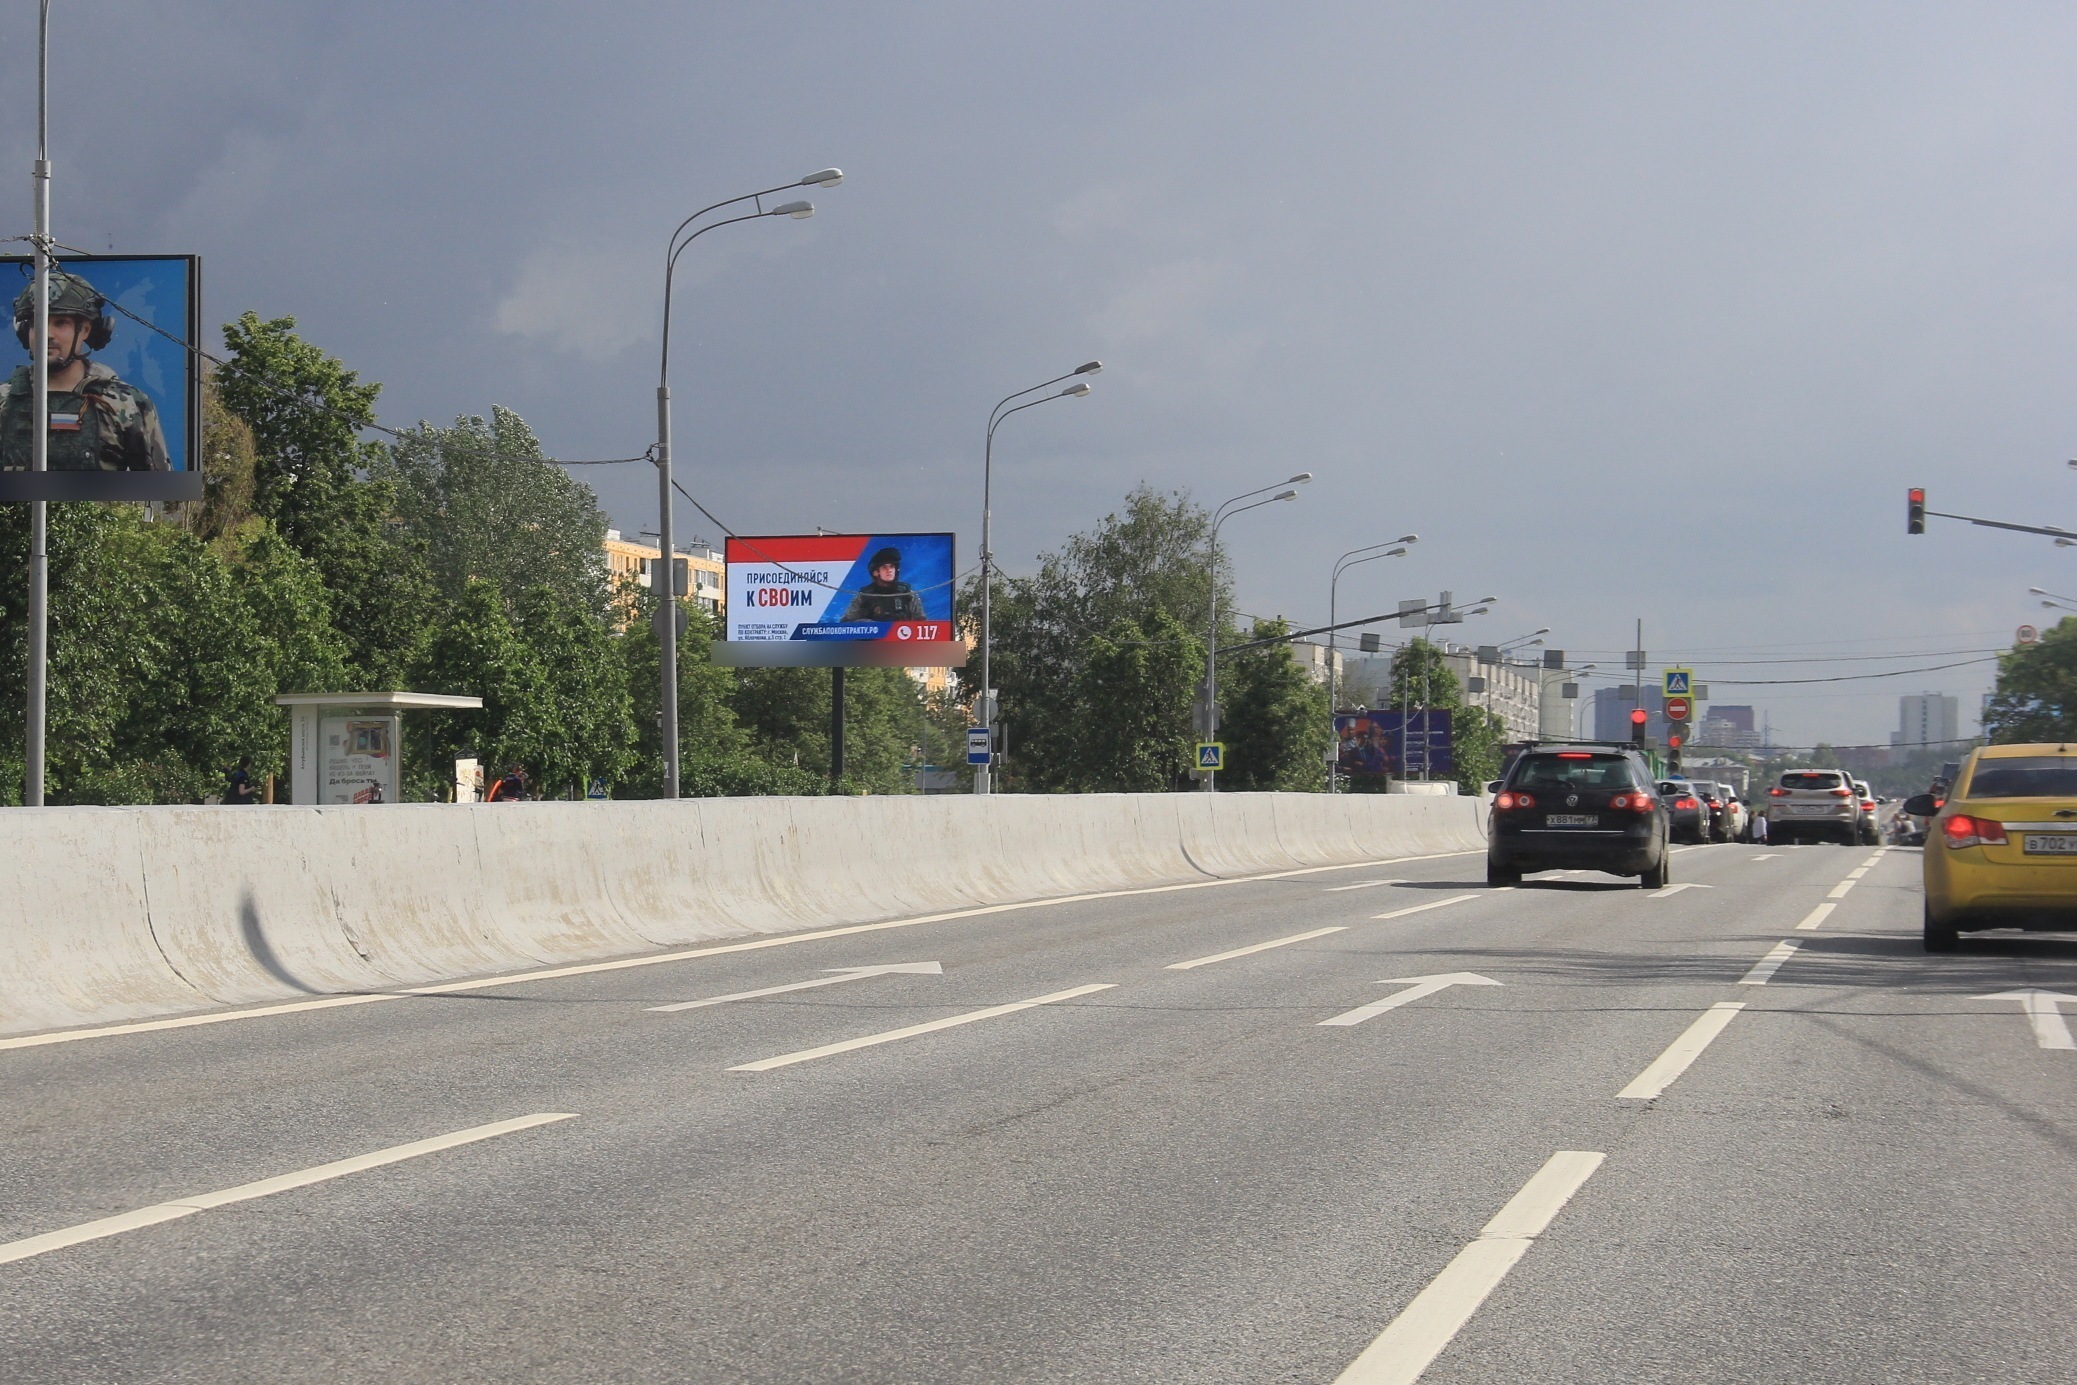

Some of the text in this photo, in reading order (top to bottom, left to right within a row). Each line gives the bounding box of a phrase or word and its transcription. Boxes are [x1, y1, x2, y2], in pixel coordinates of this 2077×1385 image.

[747, 570, 828, 585] ПРИСОЕДИНЯЙСЯ
[747, 587, 812, 607] К СВОИМ
[802, 626, 879, 635] СЛУЖБАПОКОНТРАКТУ.РФ
[916, 625, 938, 640] 117
